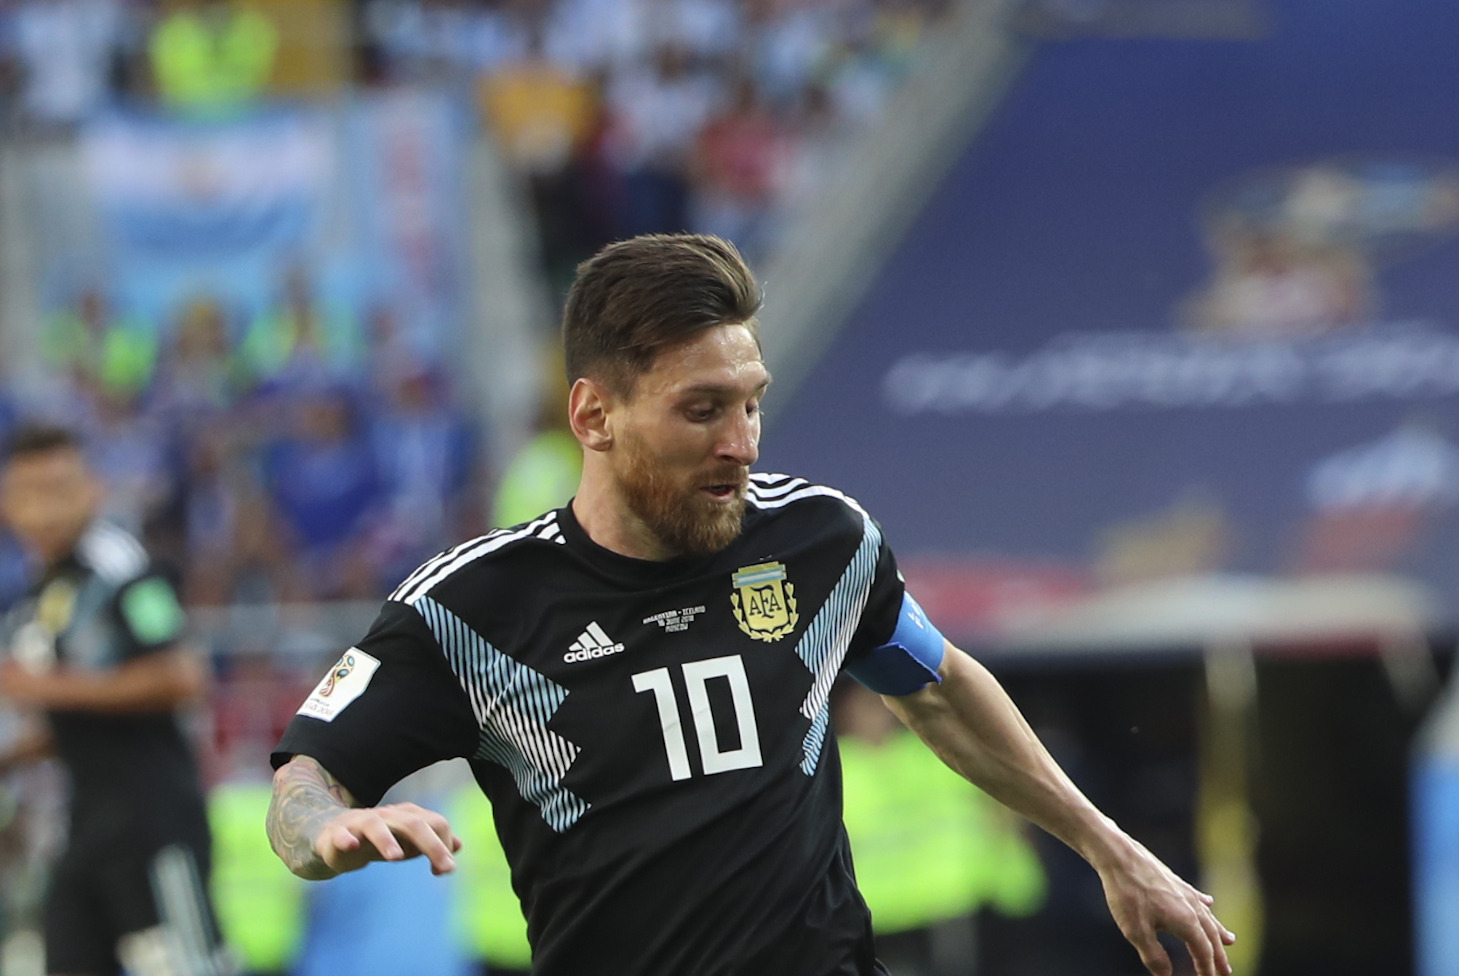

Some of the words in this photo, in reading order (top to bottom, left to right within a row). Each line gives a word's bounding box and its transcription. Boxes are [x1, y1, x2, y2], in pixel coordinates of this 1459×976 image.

[749, 584, 782, 619] AFA
[563, 642, 625, 663] adidas
[631, 654, 763, 781] 10
